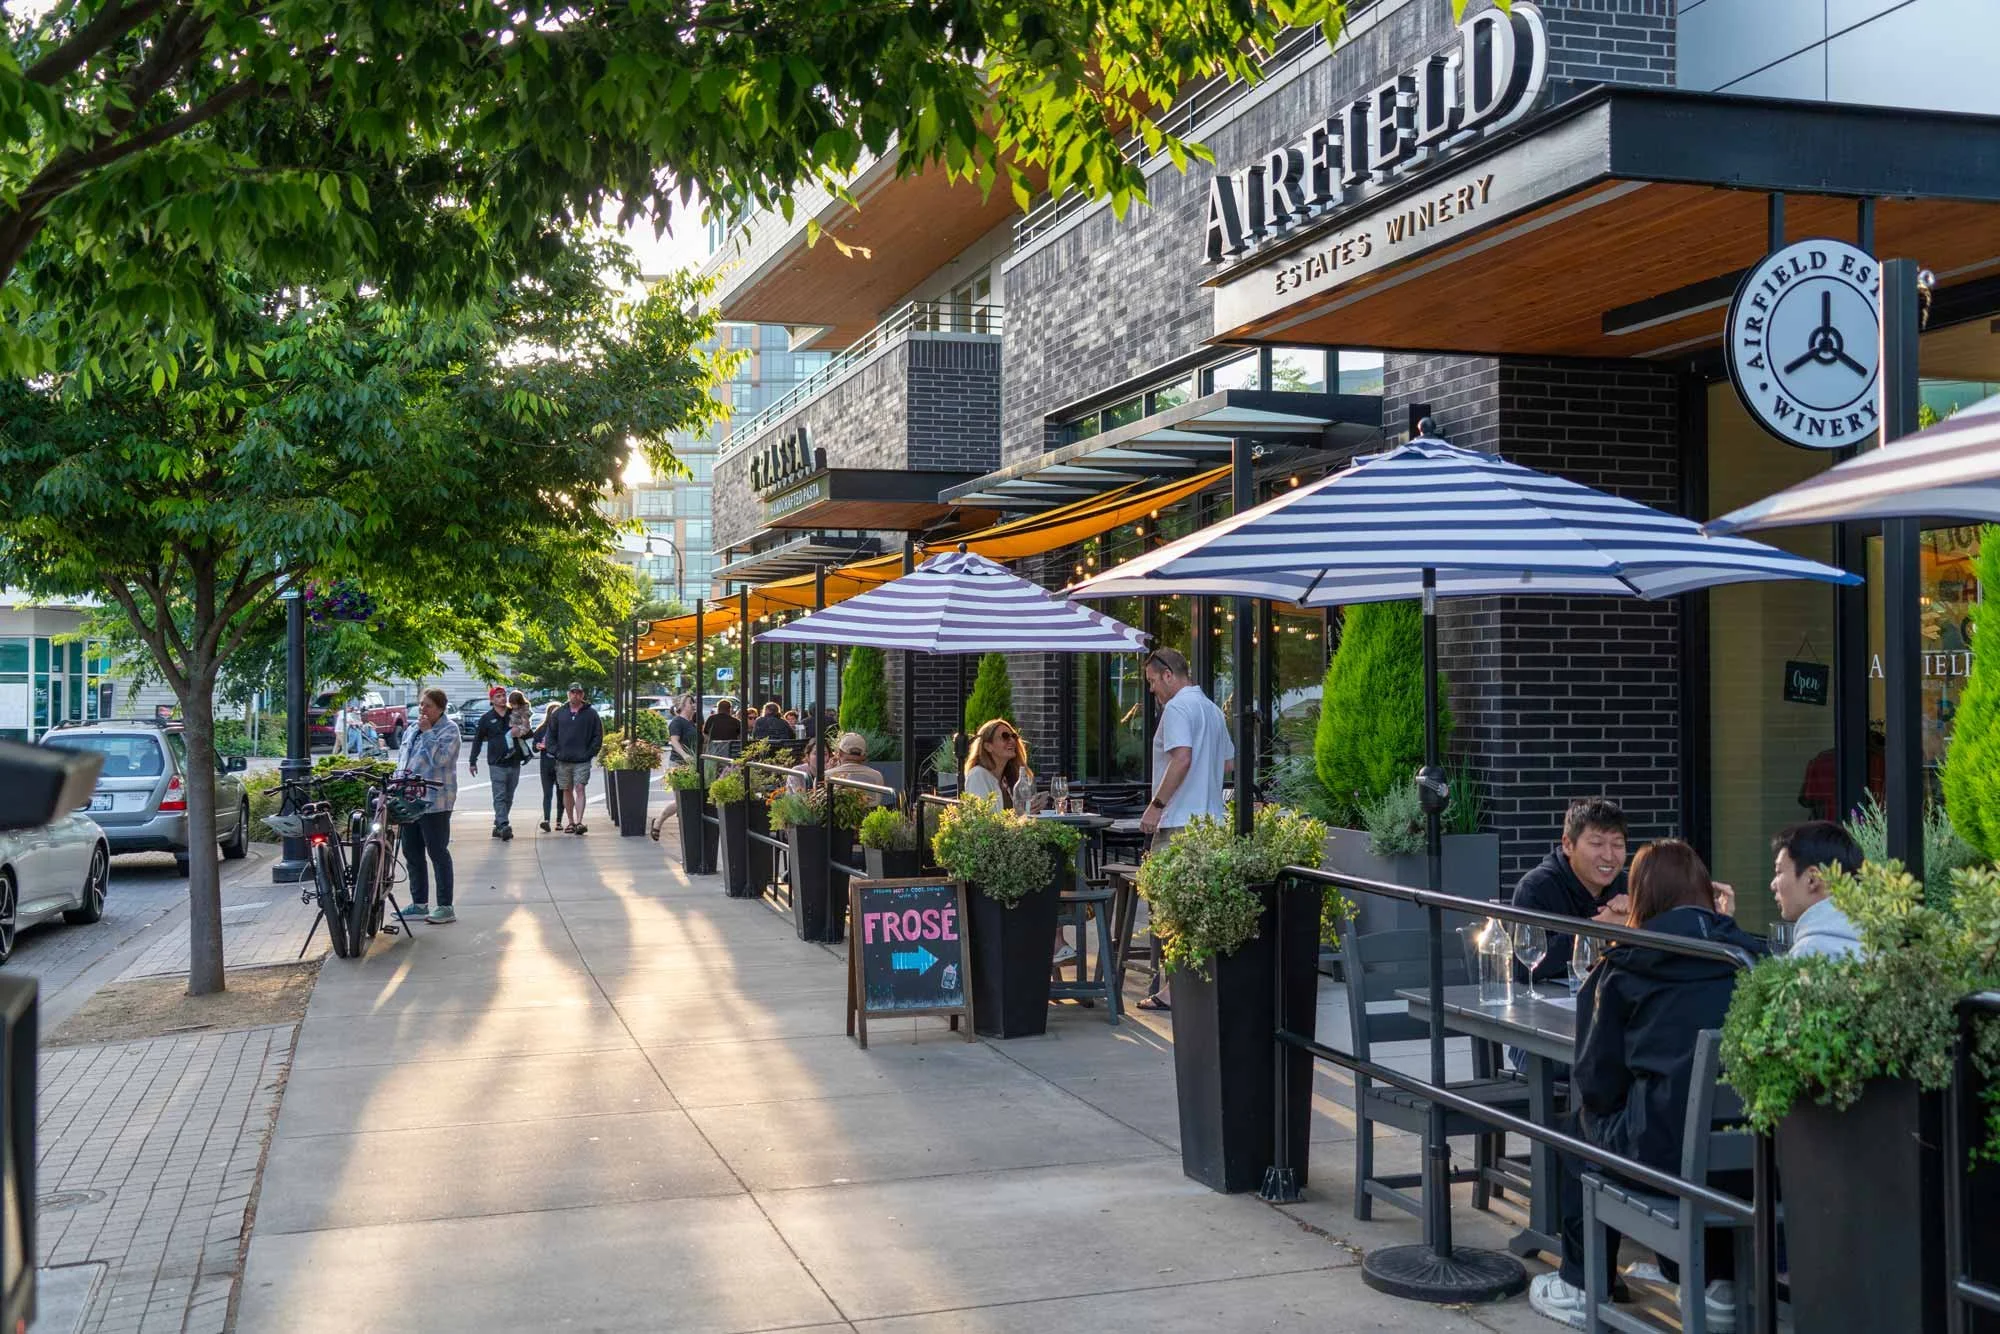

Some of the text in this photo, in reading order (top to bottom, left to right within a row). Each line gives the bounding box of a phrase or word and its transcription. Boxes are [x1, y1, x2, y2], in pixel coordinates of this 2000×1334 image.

[1201, 3, 1548, 266] AIRFIELD
[1274, 174, 1495, 296] ESTATES WINERY
[1744, 250, 1828, 370] AIRFIELD
[1771, 394, 1879, 437] WINERY
[1793, 669, 1820, 696] Open
[864, 902, 958, 944] FROSÉ
